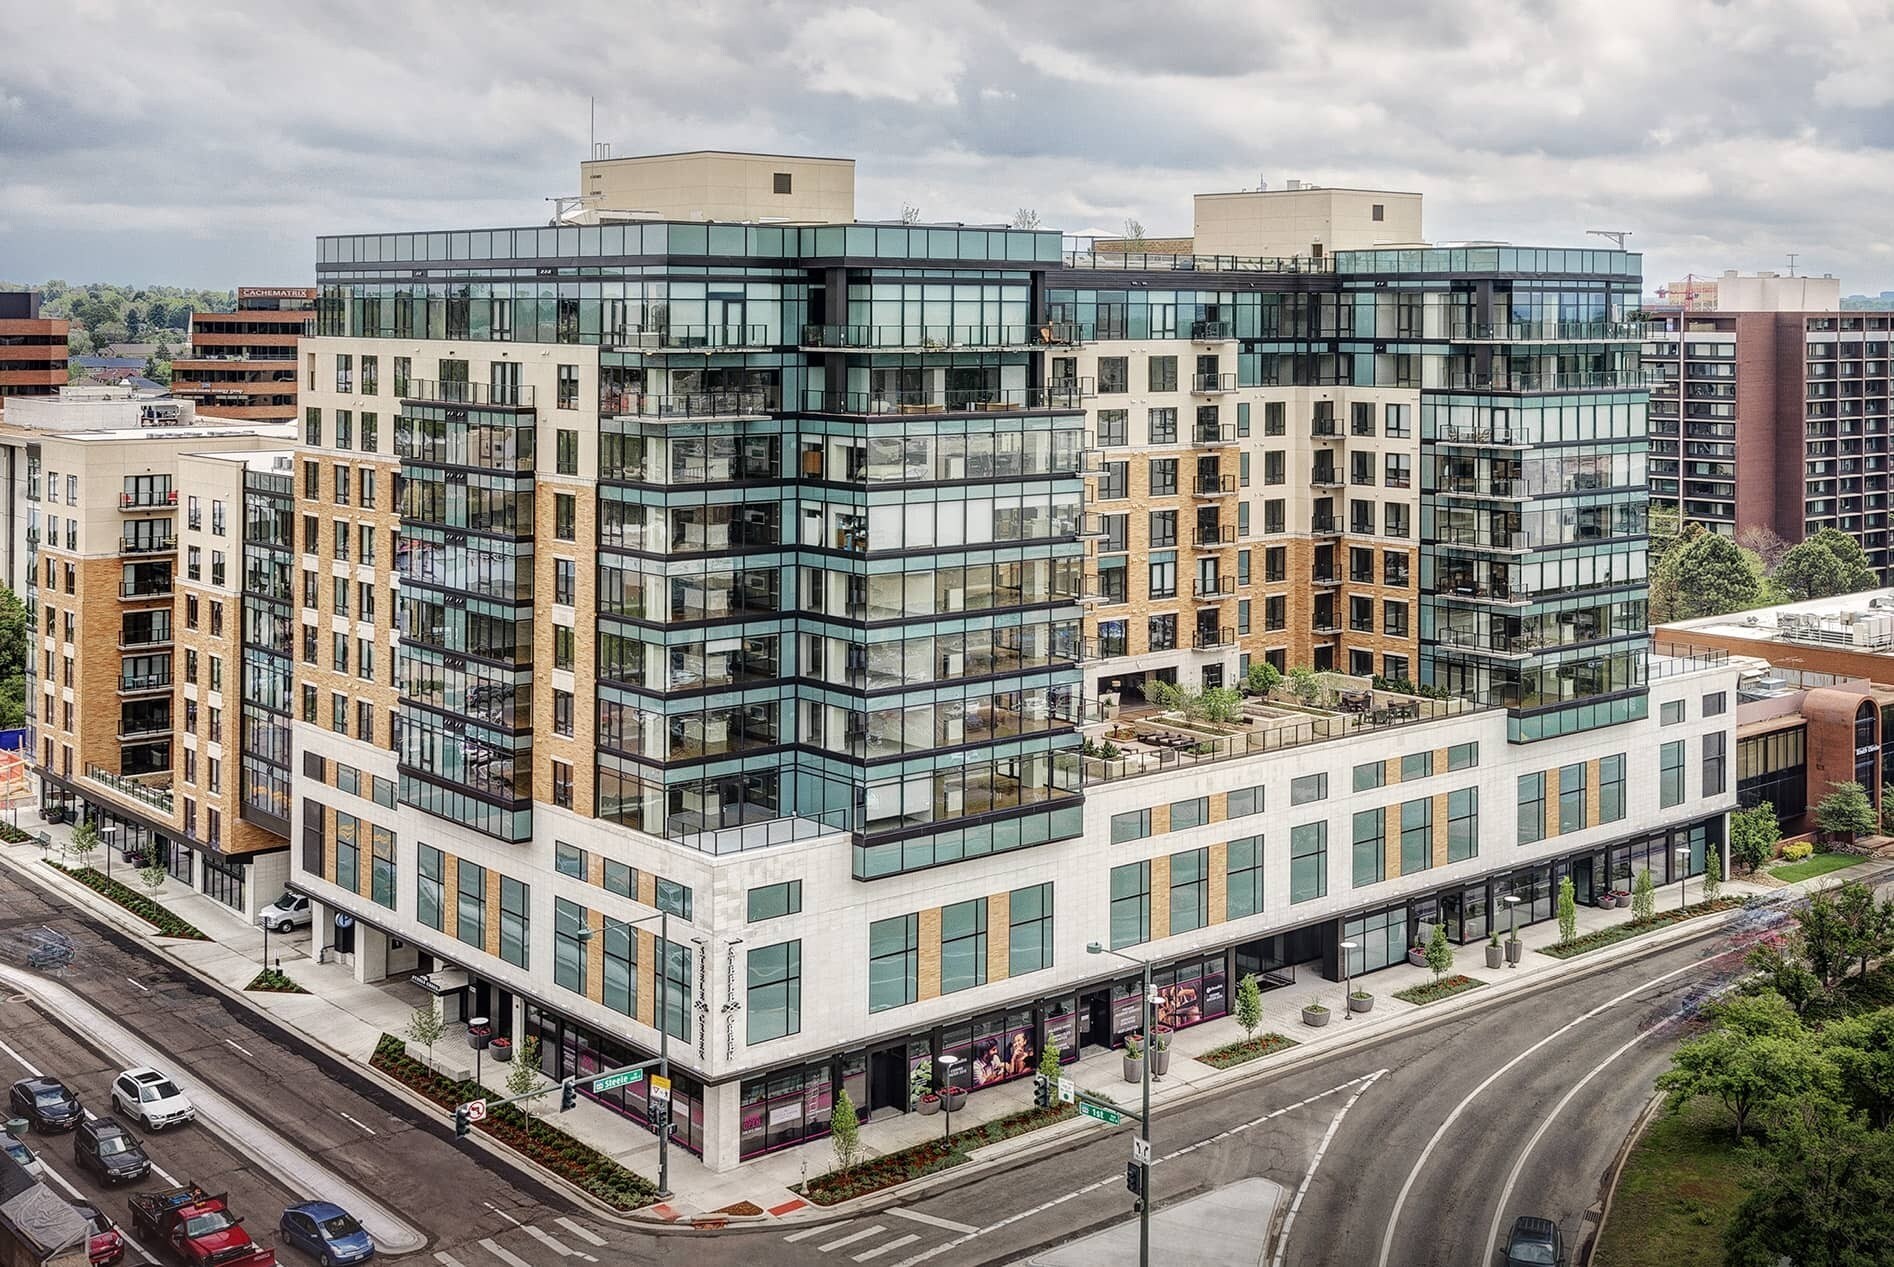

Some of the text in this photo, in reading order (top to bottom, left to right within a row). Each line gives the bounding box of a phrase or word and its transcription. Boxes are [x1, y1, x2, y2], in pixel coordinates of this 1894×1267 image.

[243, 289, 307, 298] CACHEMATRIX
[726, 1014, 736, 1061] CREEK
[604, 1074, 629, 1089] Steele
[1092, 1108, 1105, 1119] 1st
[743, 1117, 762, 1131] OPEN
